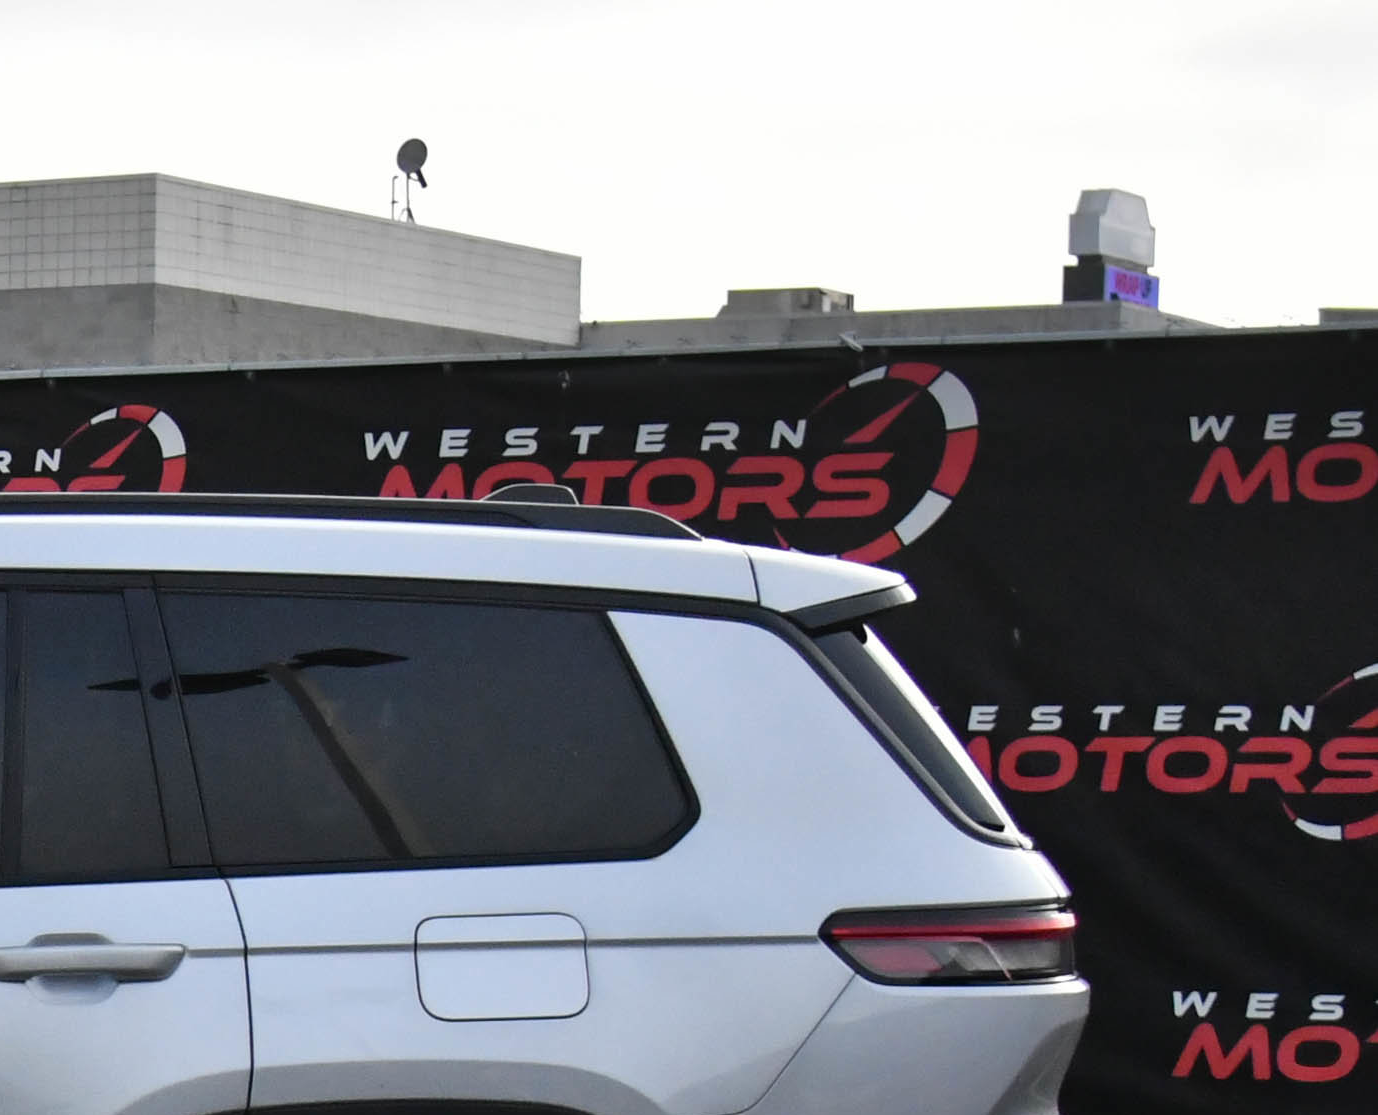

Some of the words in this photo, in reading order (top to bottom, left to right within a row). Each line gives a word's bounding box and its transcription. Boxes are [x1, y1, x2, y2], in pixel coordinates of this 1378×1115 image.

[364, 419, 807, 461] WESTERN
[932, 705, 1315, 732] ESTERN
[1172, 990, 1378, 1021] WES
[1172, 1022, 1378, 1083] MO
